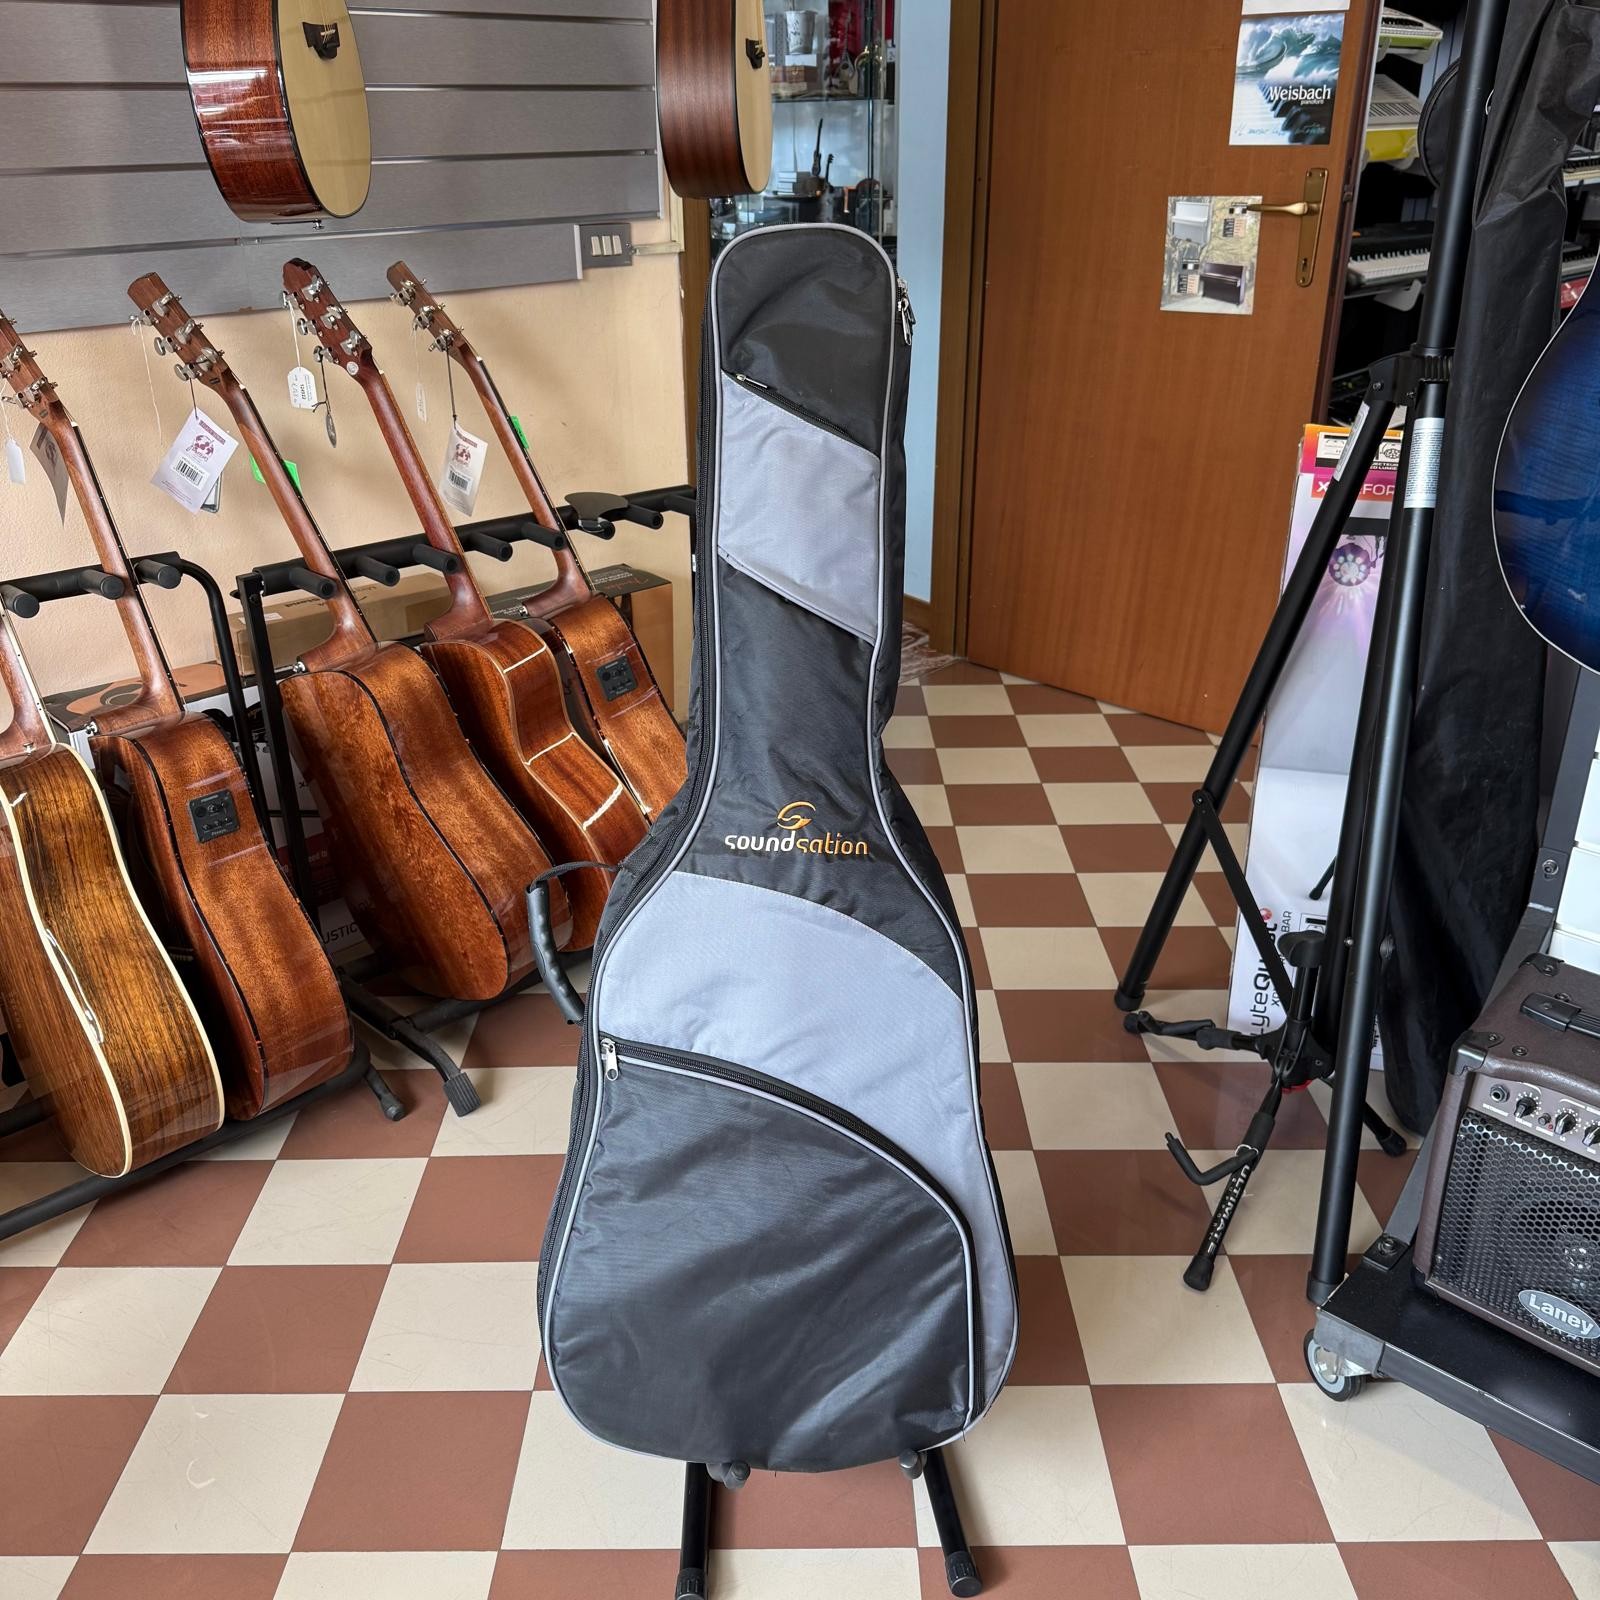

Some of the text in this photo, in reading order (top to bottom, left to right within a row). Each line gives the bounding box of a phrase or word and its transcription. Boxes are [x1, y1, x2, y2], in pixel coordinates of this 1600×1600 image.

[1269, 84, 1331, 101] Weisbach
[724, 830, 869, 856] soundsation
[322, 922, 359, 945] USTIC
[1281, 910, 1292, 933] BAR
[1207, 1164, 1251, 1254] ULTIMATE
[1528, 1293, 1595, 1336] Laney
